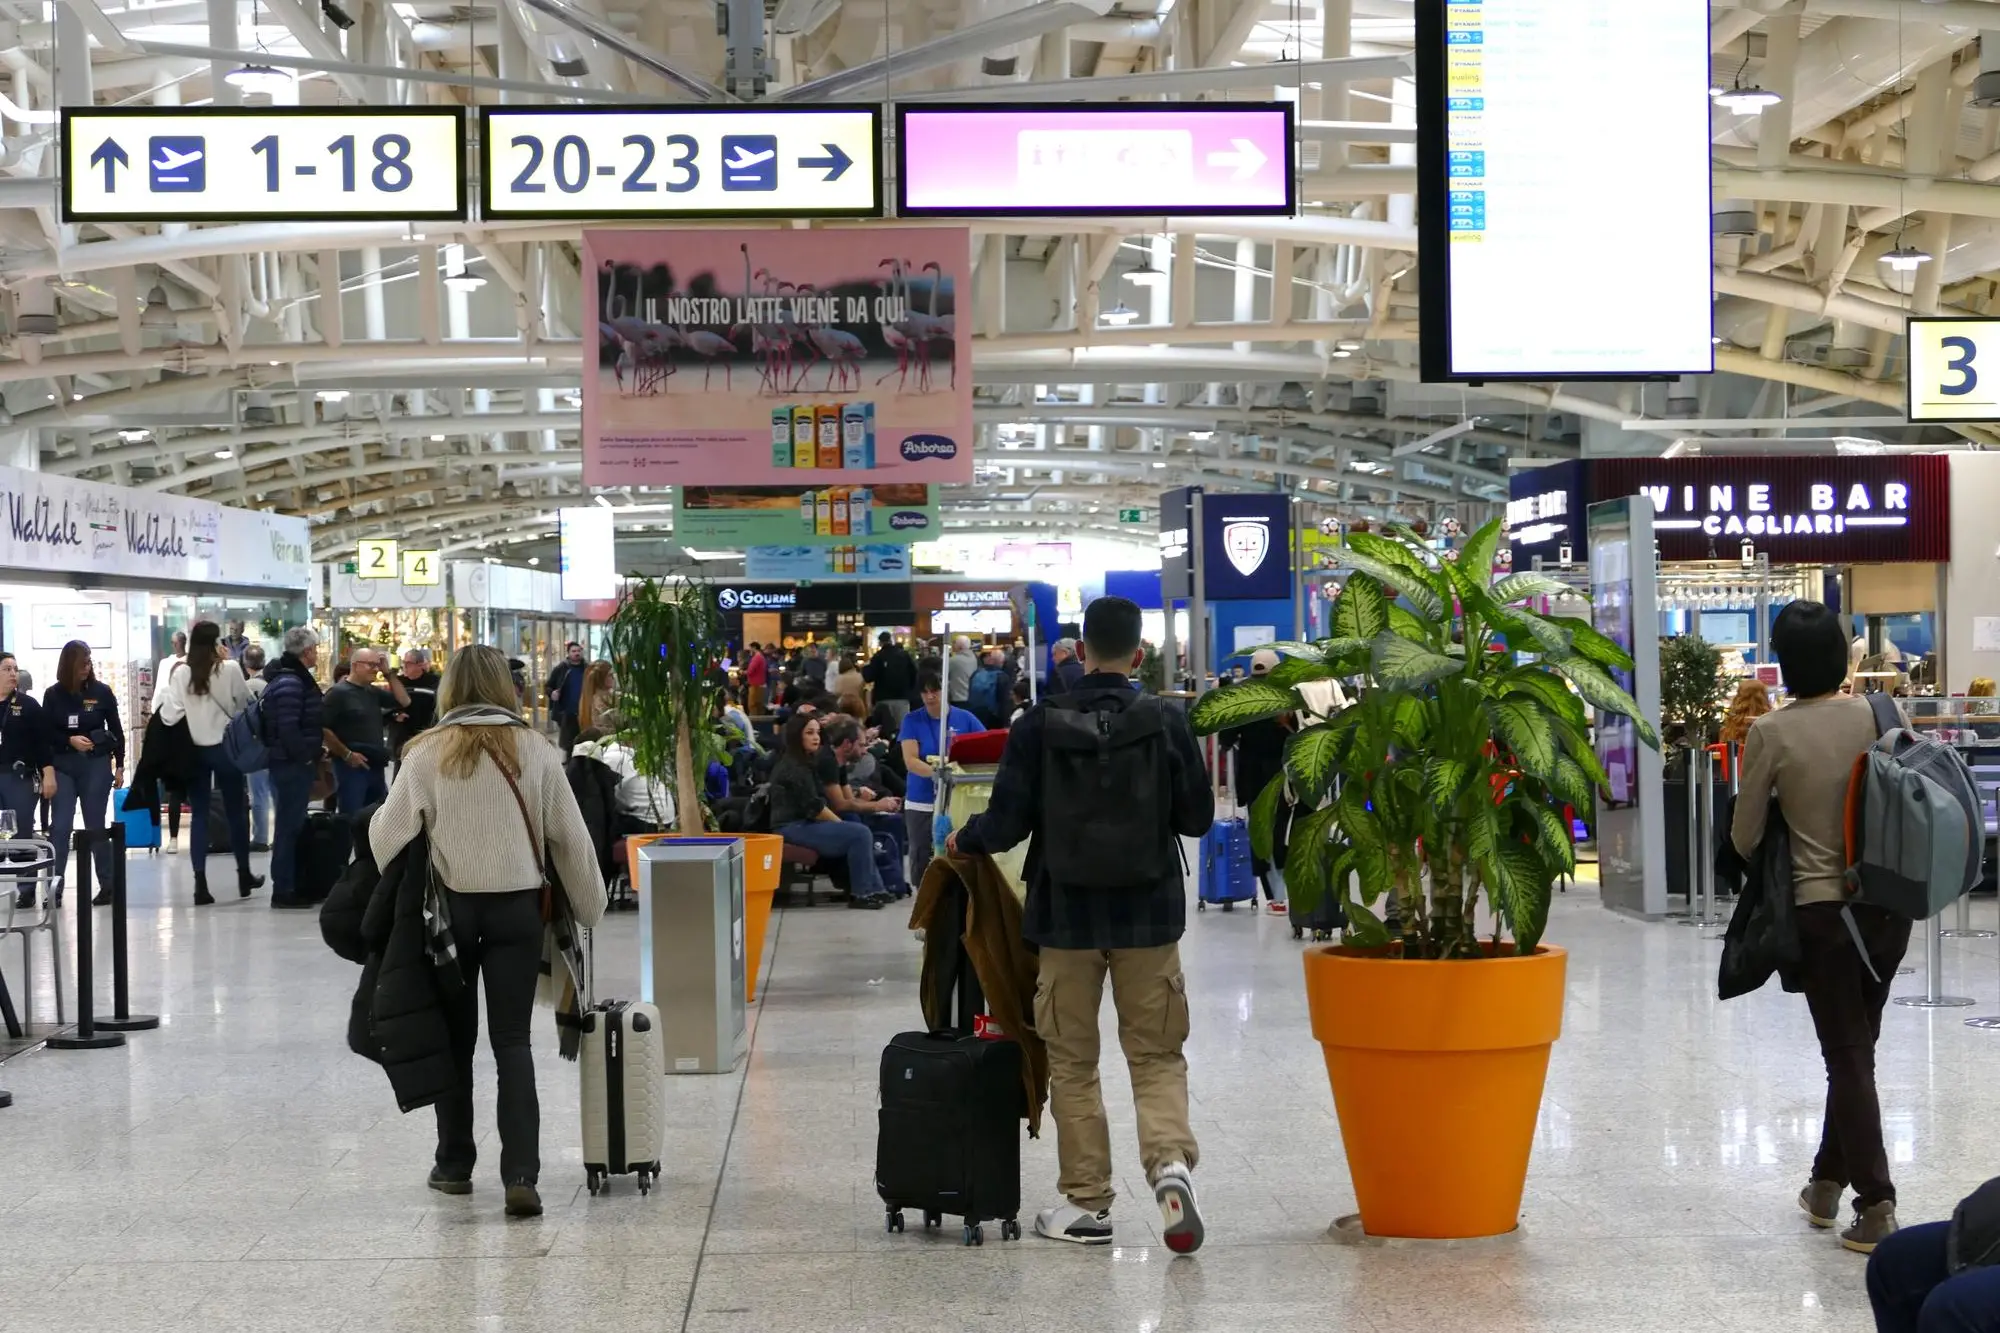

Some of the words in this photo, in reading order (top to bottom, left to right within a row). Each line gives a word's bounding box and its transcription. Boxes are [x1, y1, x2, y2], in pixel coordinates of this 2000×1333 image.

[251, 134, 413, 193] 1-18
[511, 134, 701, 194] 20-23
[646, 297, 661, 325] IL
[667, 297, 732, 326] NOSTRO
[737, 297, 785, 325] LATTE
[790, 296, 840, 324] VIENE
[847, 296, 869, 324] DA
[874, 296, 909, 324] QUI.
[1939, 335, 1979, 396] 3
[903, 441, 956, 455] Arborea
[1640, 484, 1771, 512] WINE
[1811, 483, 1908, 511] BAR
[1703, 514, 1844, 535] CAGLIARI
[371, 546, 385, 568] 2
[413, 556, 428, 576] 4
